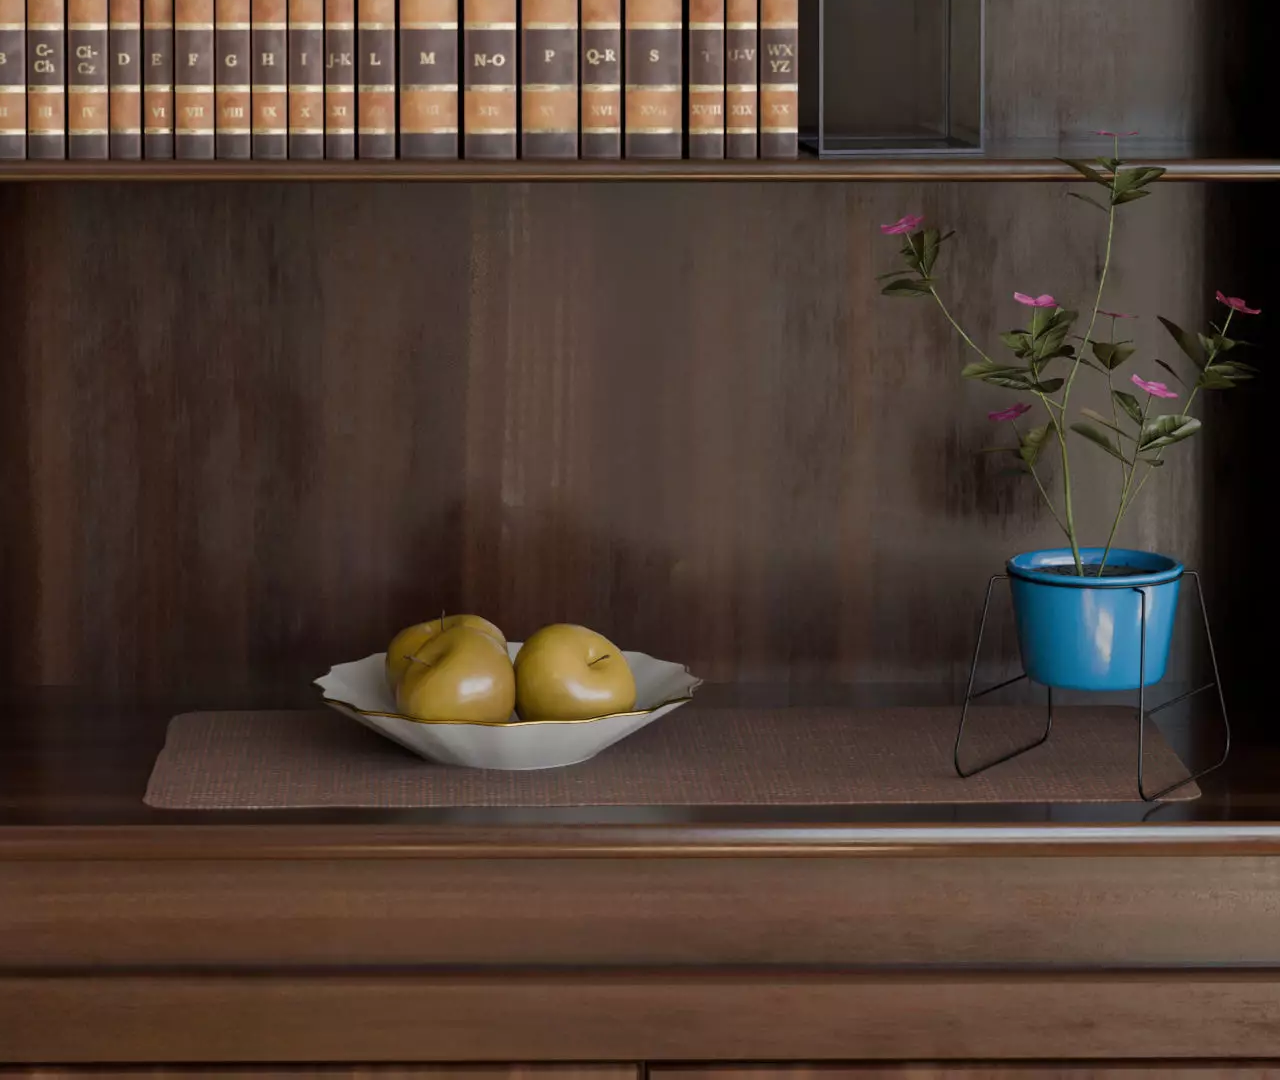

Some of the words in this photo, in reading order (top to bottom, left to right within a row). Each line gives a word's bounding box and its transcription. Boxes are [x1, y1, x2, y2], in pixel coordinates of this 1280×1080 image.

[36, 44, 54, 57] C-
[76, 45, 98, 58] Ci-
[544, 49, 555, 63] P
[586, 49, 616, 65] Q-R
[649, 49, 660, 62] S
[767, 44, 793, 57] WX
[117, 53, 131, 66] D
[188, 53, 199, 66] F
[225, 54, 237, 67] G
[262, 52, 274, 66] H
[301, 52, 307, 66] I
[326, 52, 352, 69] J-K
[370, 52, 381, 66] L
[420, 52, 436, 65] M
[474, 53, 506, 67] N-O
[34, 60, 55, 73] Ch
[77, 62, 96, 74] Cz
[770, 60, 791, 73] YZ
[82, 106, 96, 118] IV
[152, 107, 165, 118] VI
[185, 106, 204, 117] VII
[223, 107, 244, 118] VIII
[301, 106, 311, 118] X
[332, 106, 347, 117] XI
[591, 105, 613, 116] XVI
[732, 105, 752, 116] XIX
[771, 104, 791, 115] XX
